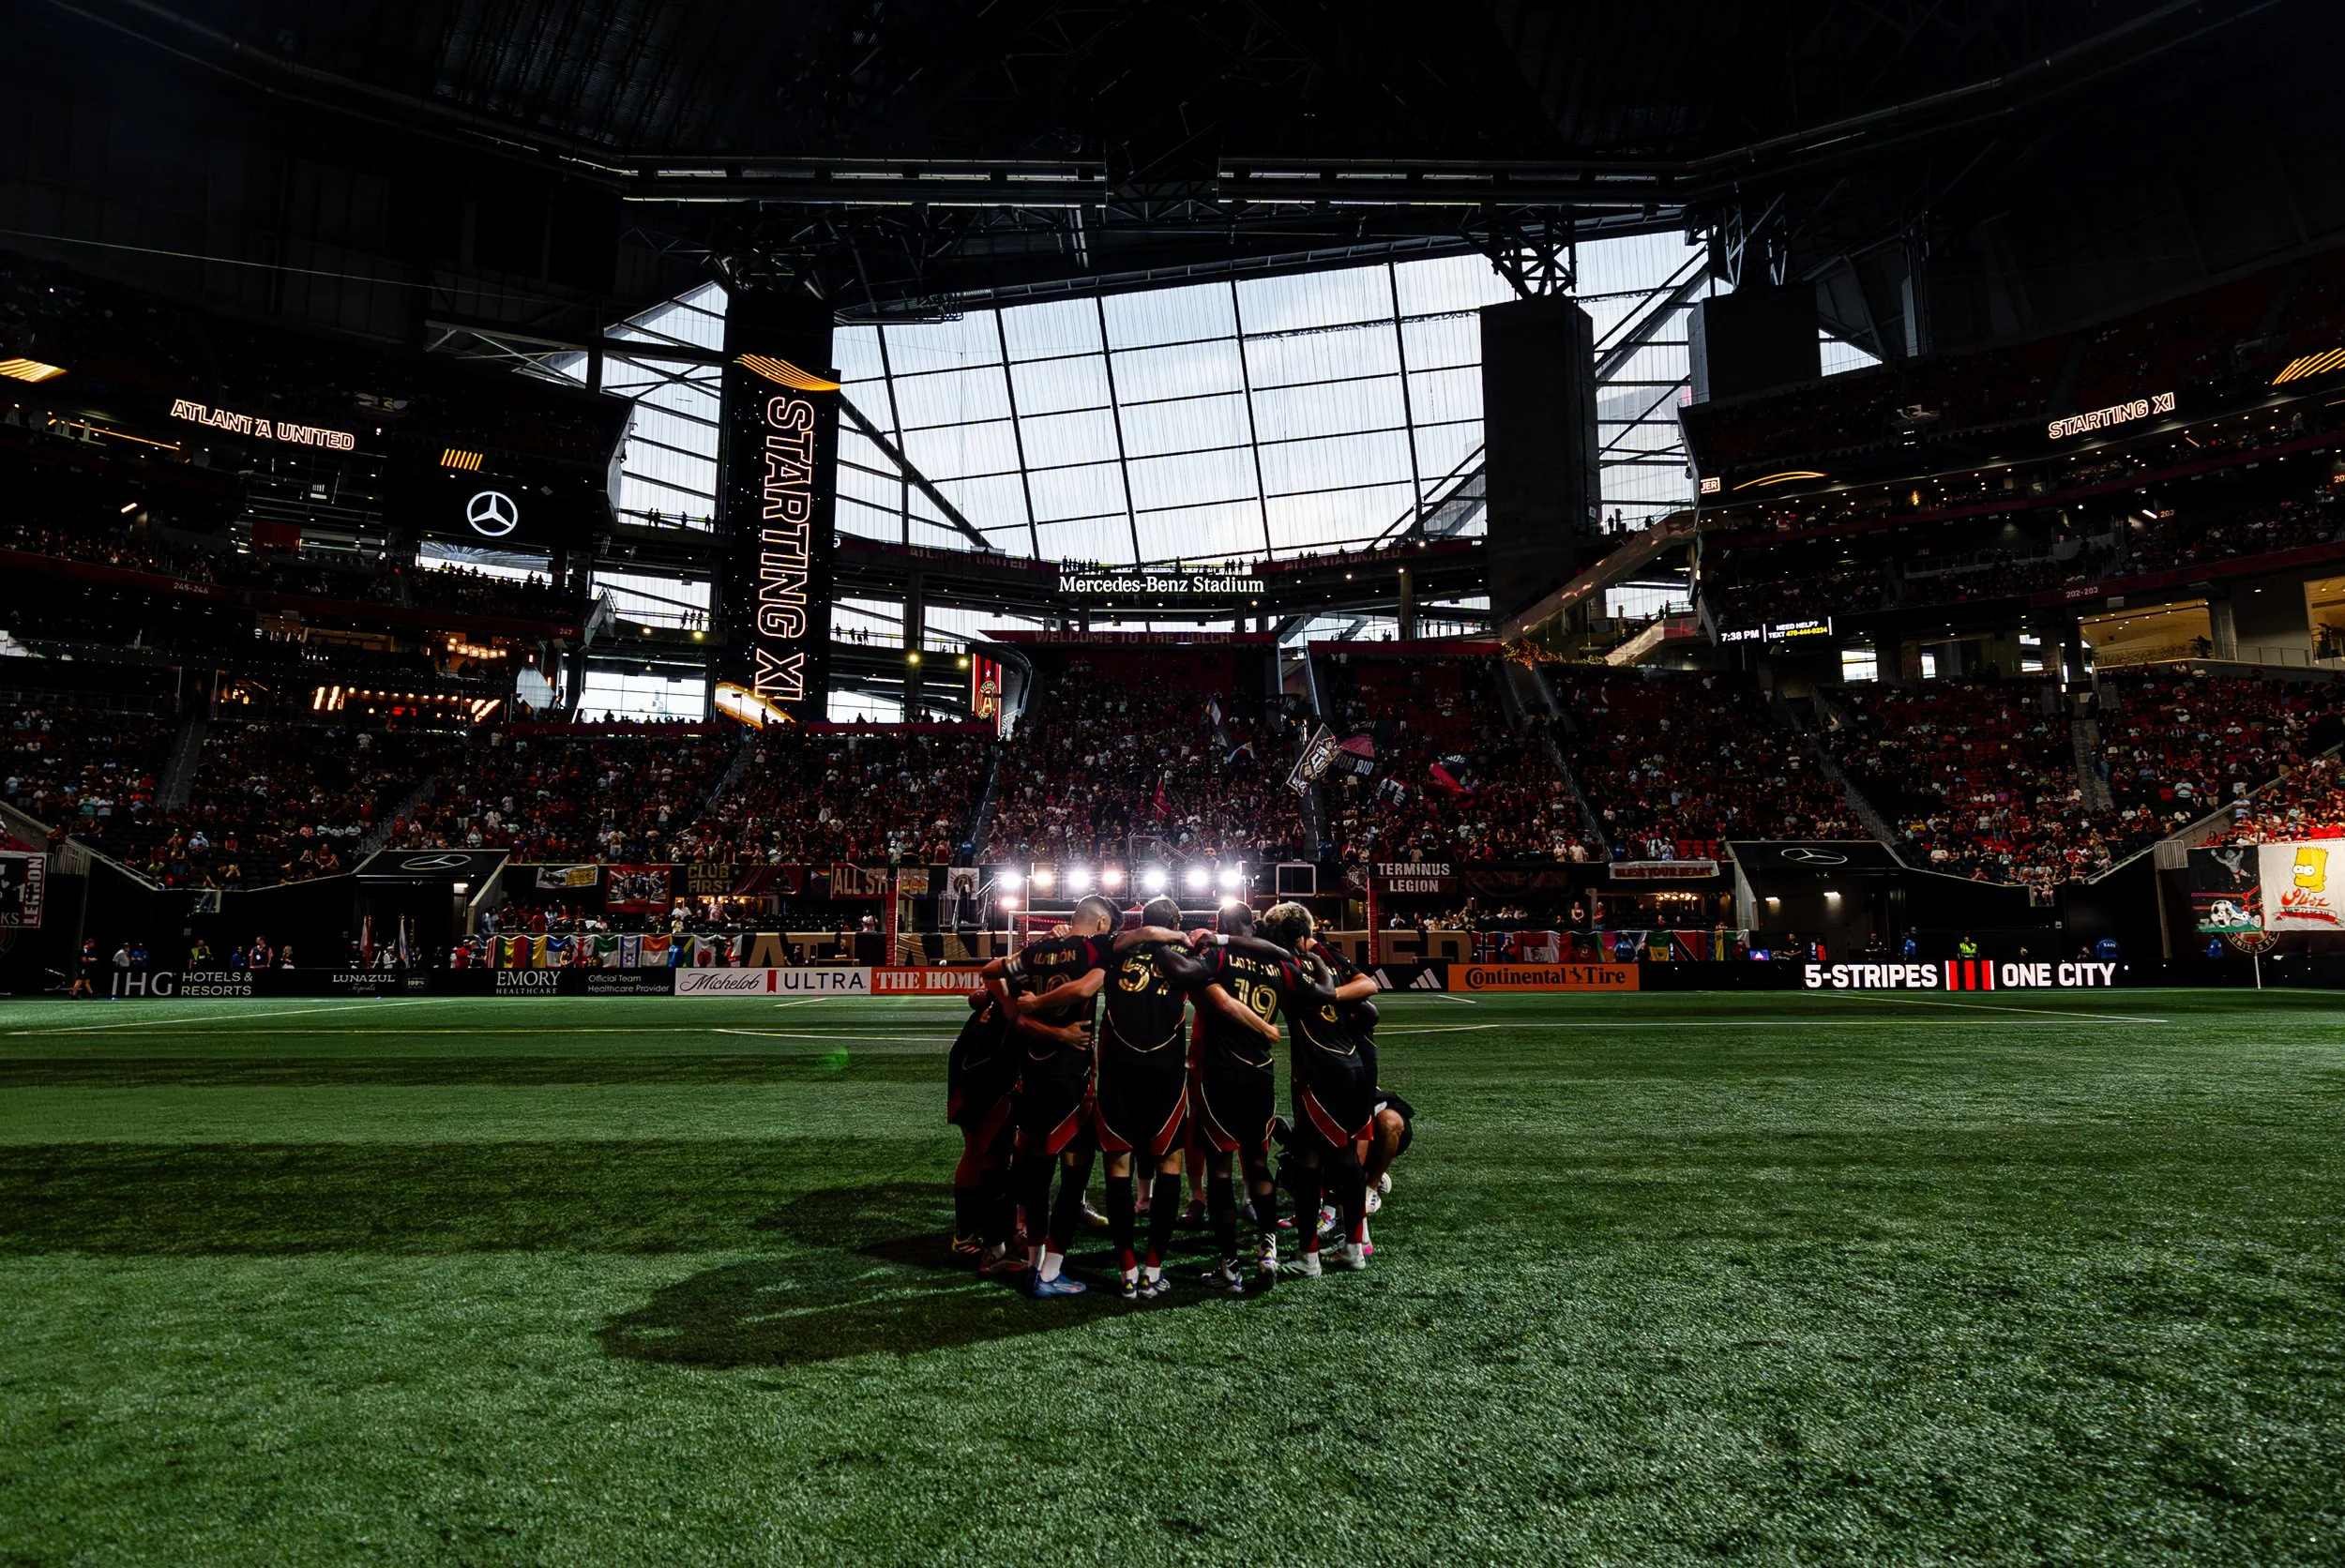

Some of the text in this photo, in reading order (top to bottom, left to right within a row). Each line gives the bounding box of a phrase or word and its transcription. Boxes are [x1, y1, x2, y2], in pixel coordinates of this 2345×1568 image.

[2048, 392, 2176, 440] STARTING XI
[170, 399, 355, 451] ATLANTA UNITED
[754, 396, 814, 701] STARTING XI
[1058, 575, 1264, 594] Mercedes-Benz Stadium
[2065, 586, 2099, 599] 202-203
[1776, 623, 1795, 631] NEED
[1035, 631, 1114, 644] WELCOME
[1120, 632, 1138, 644] TO
[1144, 632, 1174, 644] THE
[1720, 629, 1760, 642] 7:38 PM
[687, 864, 730, 879] CLUB
[1376, 862, 1451, 877] TERMINUS
[687, 879, 734, 893] FIRST
[833, 867, 862, 895] ALL
[1389, 879, 1440, 893] LEGION
[182, 972, 253, 982] HOTELS &
[332, 974, 396, 983] LUNAZUL
[496, 971, 561, 986] EMORY
[588, 974, 642, 983] Official Team
[679, 972, 865, 992] Michelob ULTRA
[876, 972, 985, 990] THE HOME
[1465, 967, 1626, 989] Continental Tire
[1804, 962, 2116, 988] 5-STRIPES ONE CITY
[111, 971, 174, 996] IHG
[181, 985, 252, 996] RESORTS
[587, 984, 670, 993] Healthcare Provider
[1233, 977, 1277, 1025] 19
